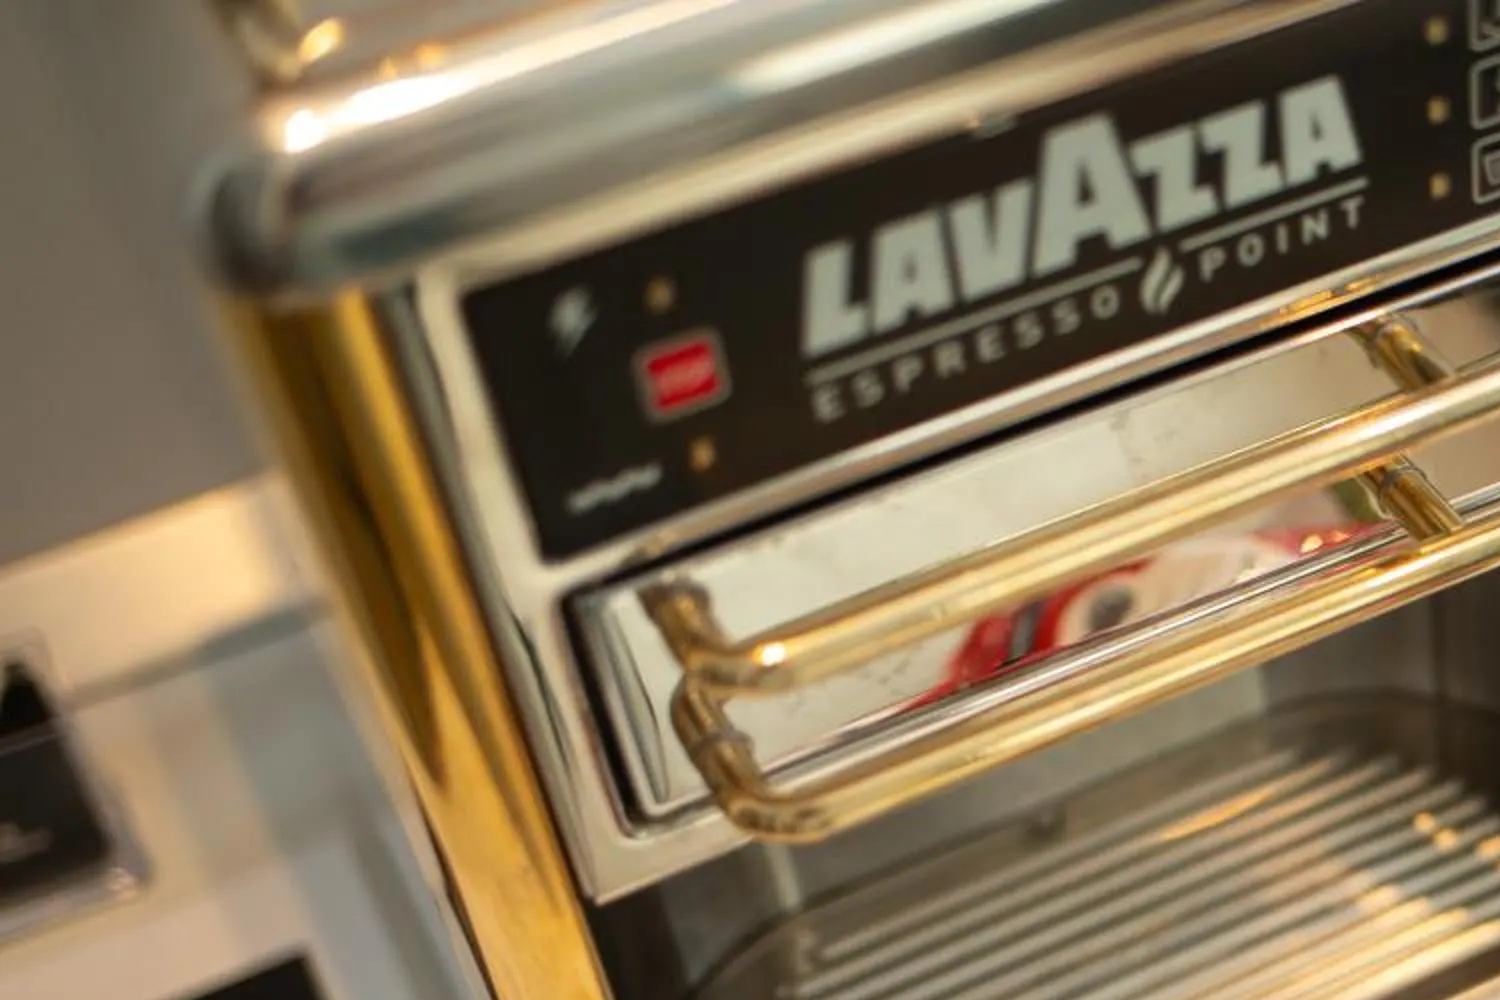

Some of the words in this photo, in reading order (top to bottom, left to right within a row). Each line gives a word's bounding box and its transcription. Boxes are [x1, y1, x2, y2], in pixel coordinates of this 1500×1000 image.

[803, 73, 1363, 358] LAVAZZA
[810, 285, 1122, 422] ESPRESSO
[1199, 196, 1367, 282] POINT
